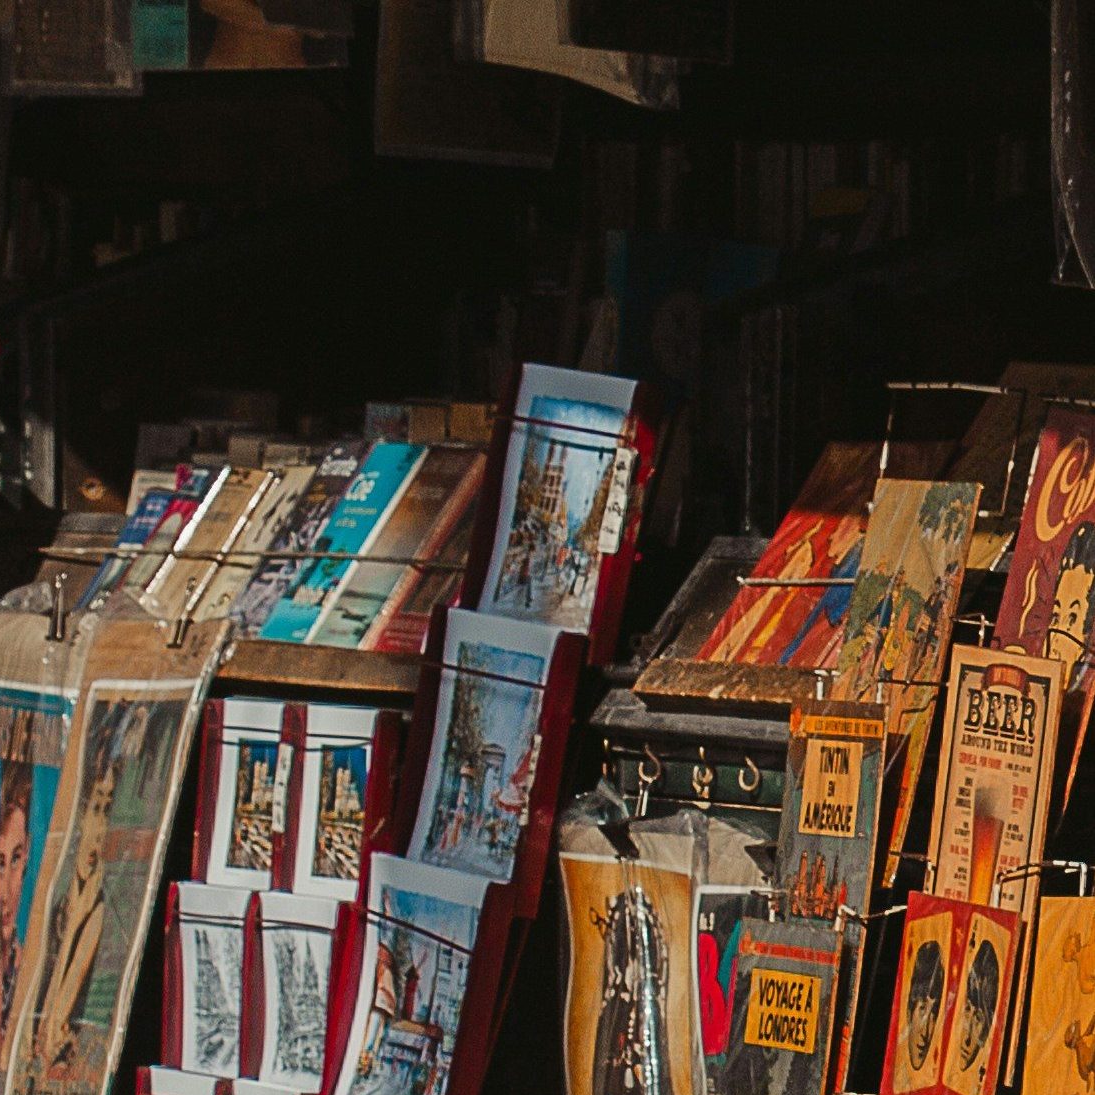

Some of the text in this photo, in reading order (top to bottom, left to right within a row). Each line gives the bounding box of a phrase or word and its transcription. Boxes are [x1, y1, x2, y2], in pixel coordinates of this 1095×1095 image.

[964, 687, 1036, 744] BEER
[820, 745, 850, 775] TINTIN
[759, 976, 814, 1013] VOYAGE À
[758, 1013, 808, 1047] LONDRES
